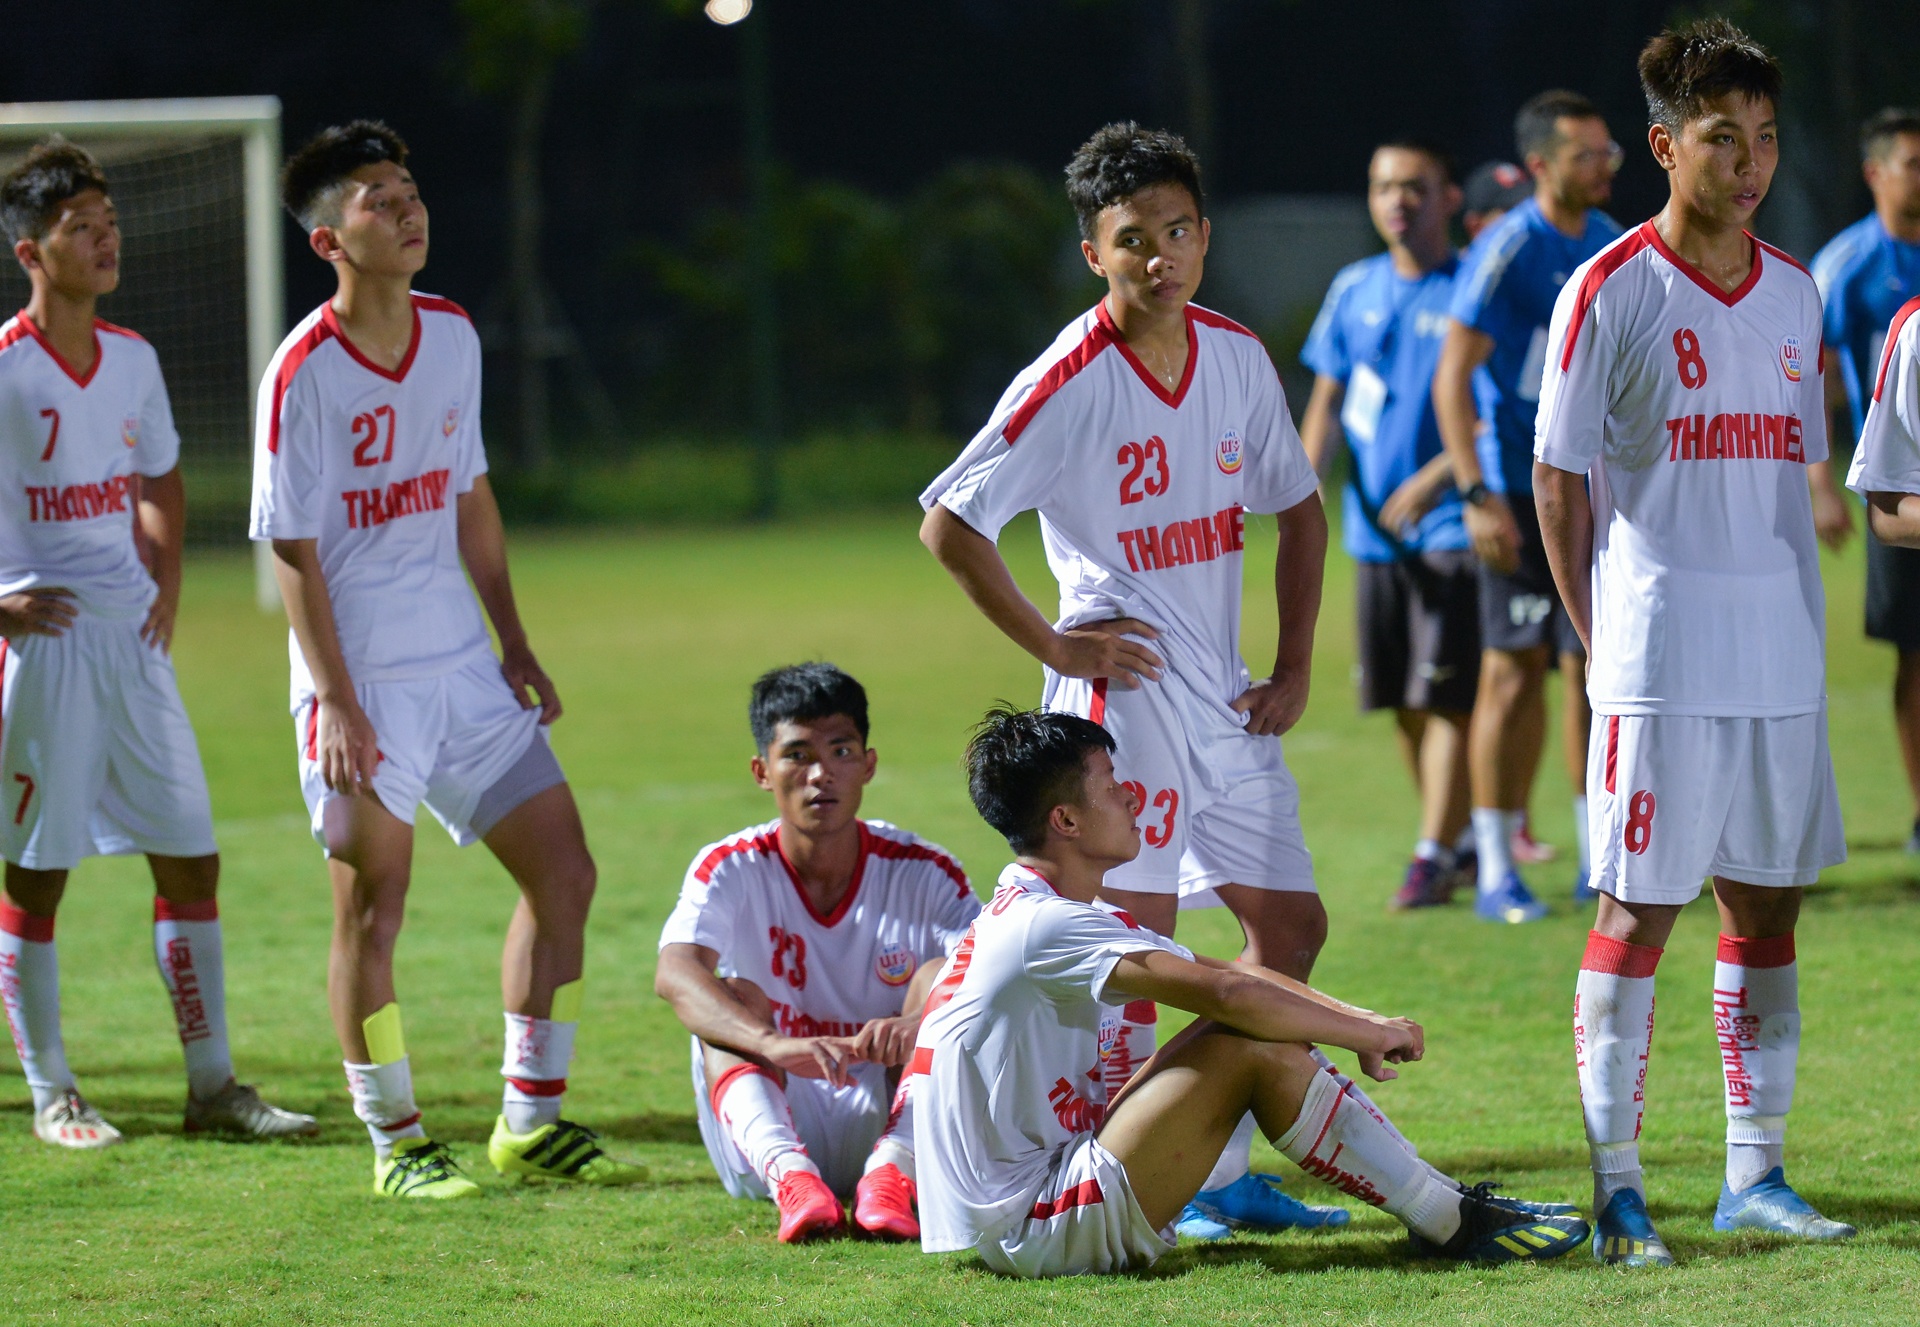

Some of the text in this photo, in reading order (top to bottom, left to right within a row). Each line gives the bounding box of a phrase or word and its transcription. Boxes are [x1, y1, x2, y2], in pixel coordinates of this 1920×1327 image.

[1673, 327, 1707, 390] 8
[39, 408, 60, 462] 7
[351, 403, 396, 467] 27
[1117, 435, 1170, 506] 23
[14, 771, 36, 826] 7
[1624, 789, 1656, 856] 8
